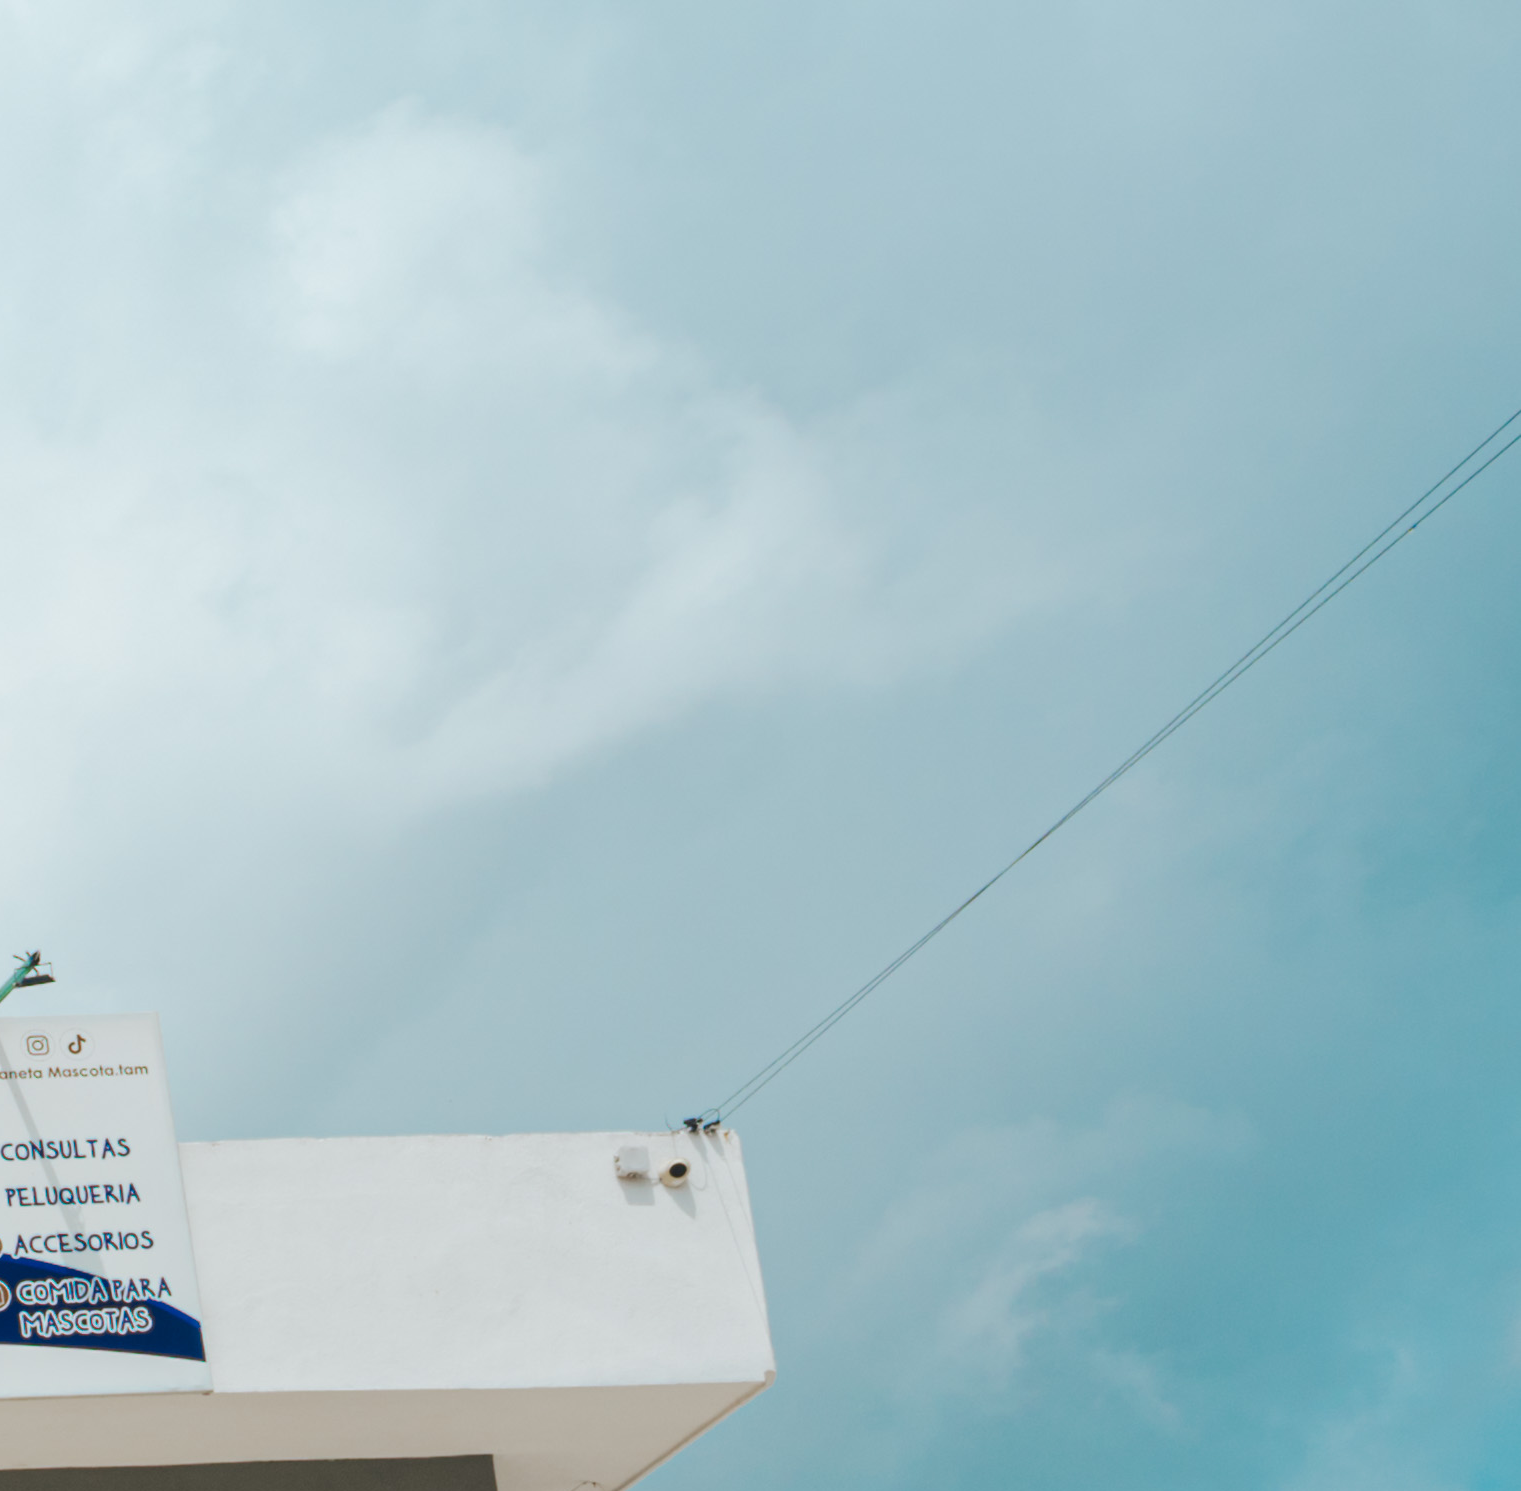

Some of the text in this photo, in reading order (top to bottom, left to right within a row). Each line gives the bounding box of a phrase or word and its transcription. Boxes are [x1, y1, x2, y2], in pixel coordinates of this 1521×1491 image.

[48, 1064, 149, 1079] Mascota.tam
[0, 1138, 131, 1161] CONSULTAS
[5, 1183, 141, 1207] PELUQUERIA
[15, 1230, 154, 1257] ACCESORIOS
[16, 1277, 173, 1304] COMIDA PARA
[18, 1306, 153, 1338] MASCOTAS
